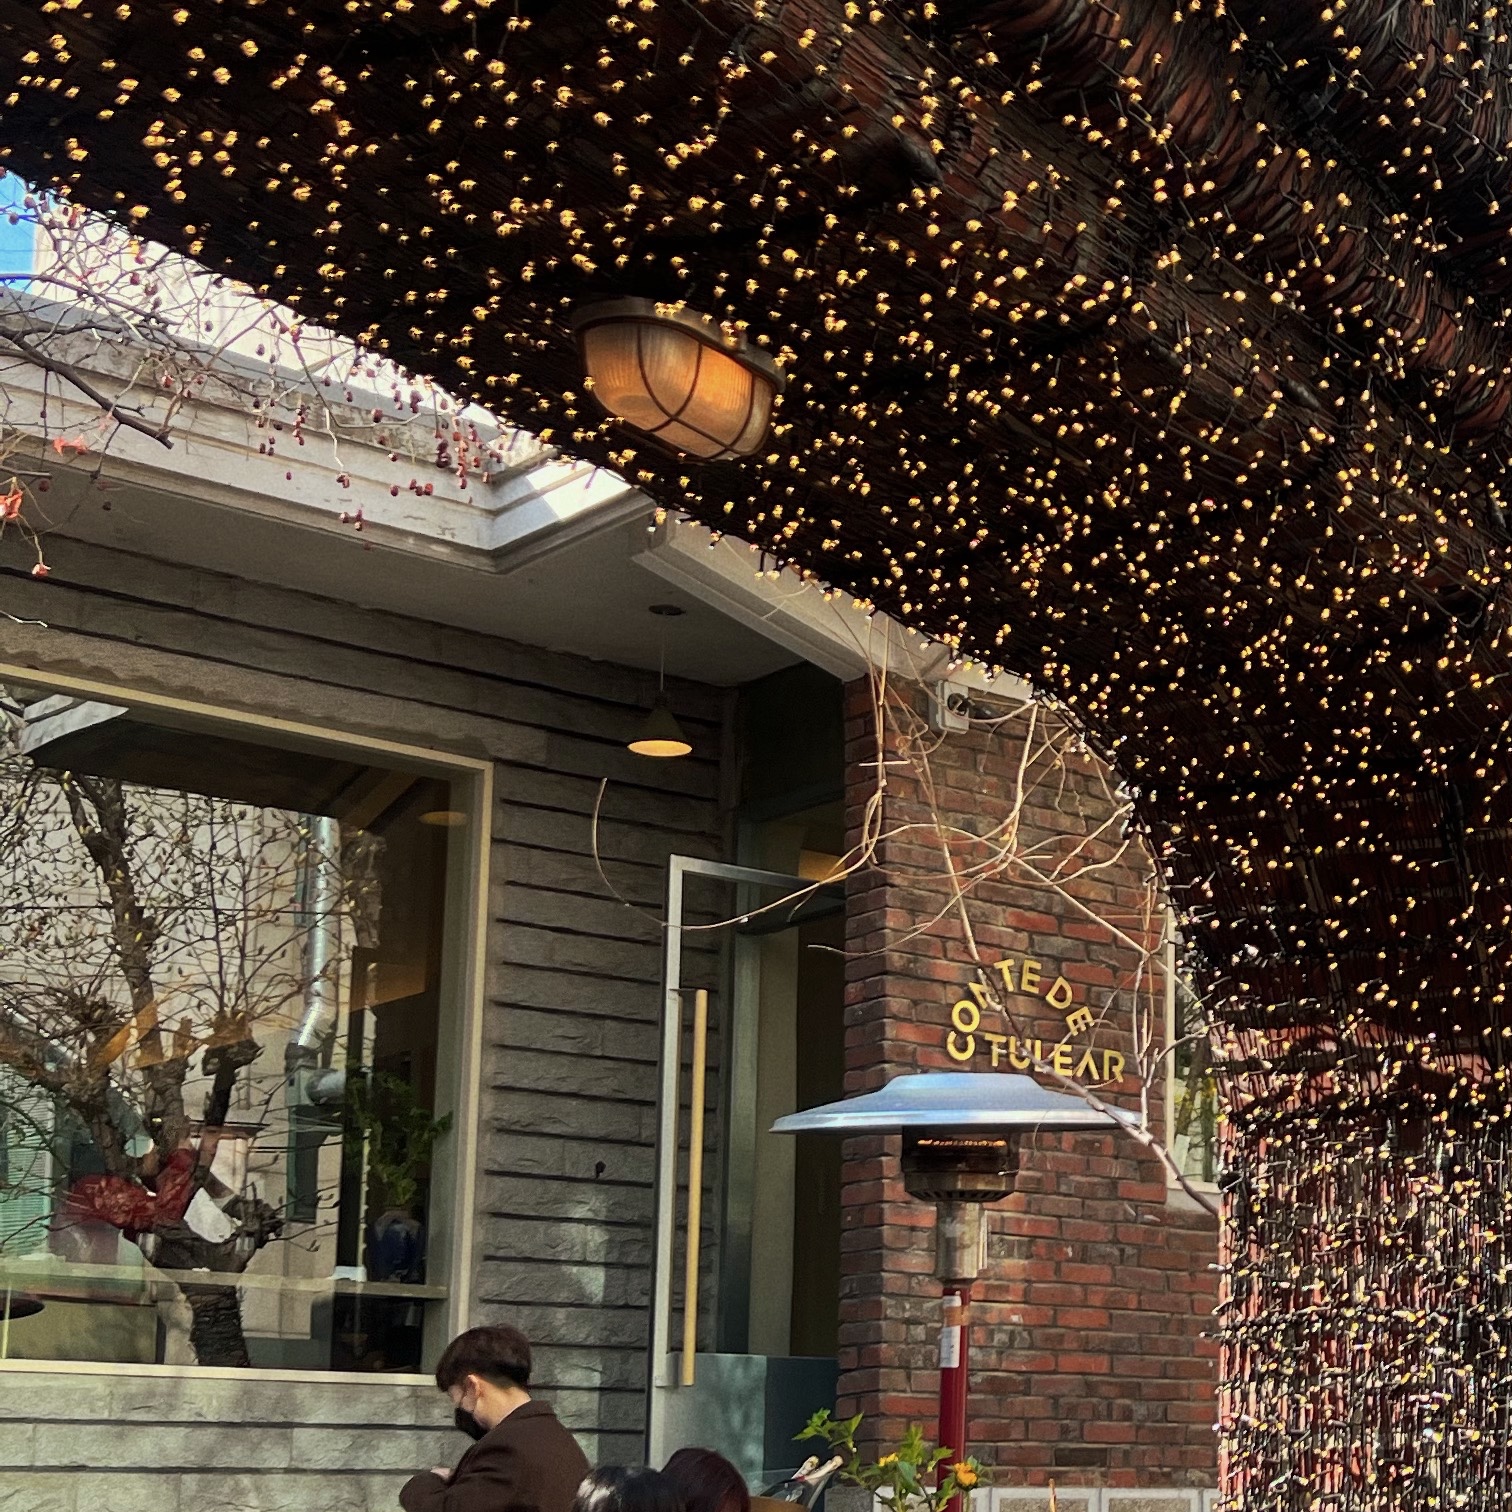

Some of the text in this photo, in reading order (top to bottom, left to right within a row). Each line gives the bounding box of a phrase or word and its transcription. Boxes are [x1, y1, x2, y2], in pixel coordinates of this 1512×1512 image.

[946, 959, 1095, 1061] CONTE DE
[984, 1033, 1125, 1083] TULEAR
